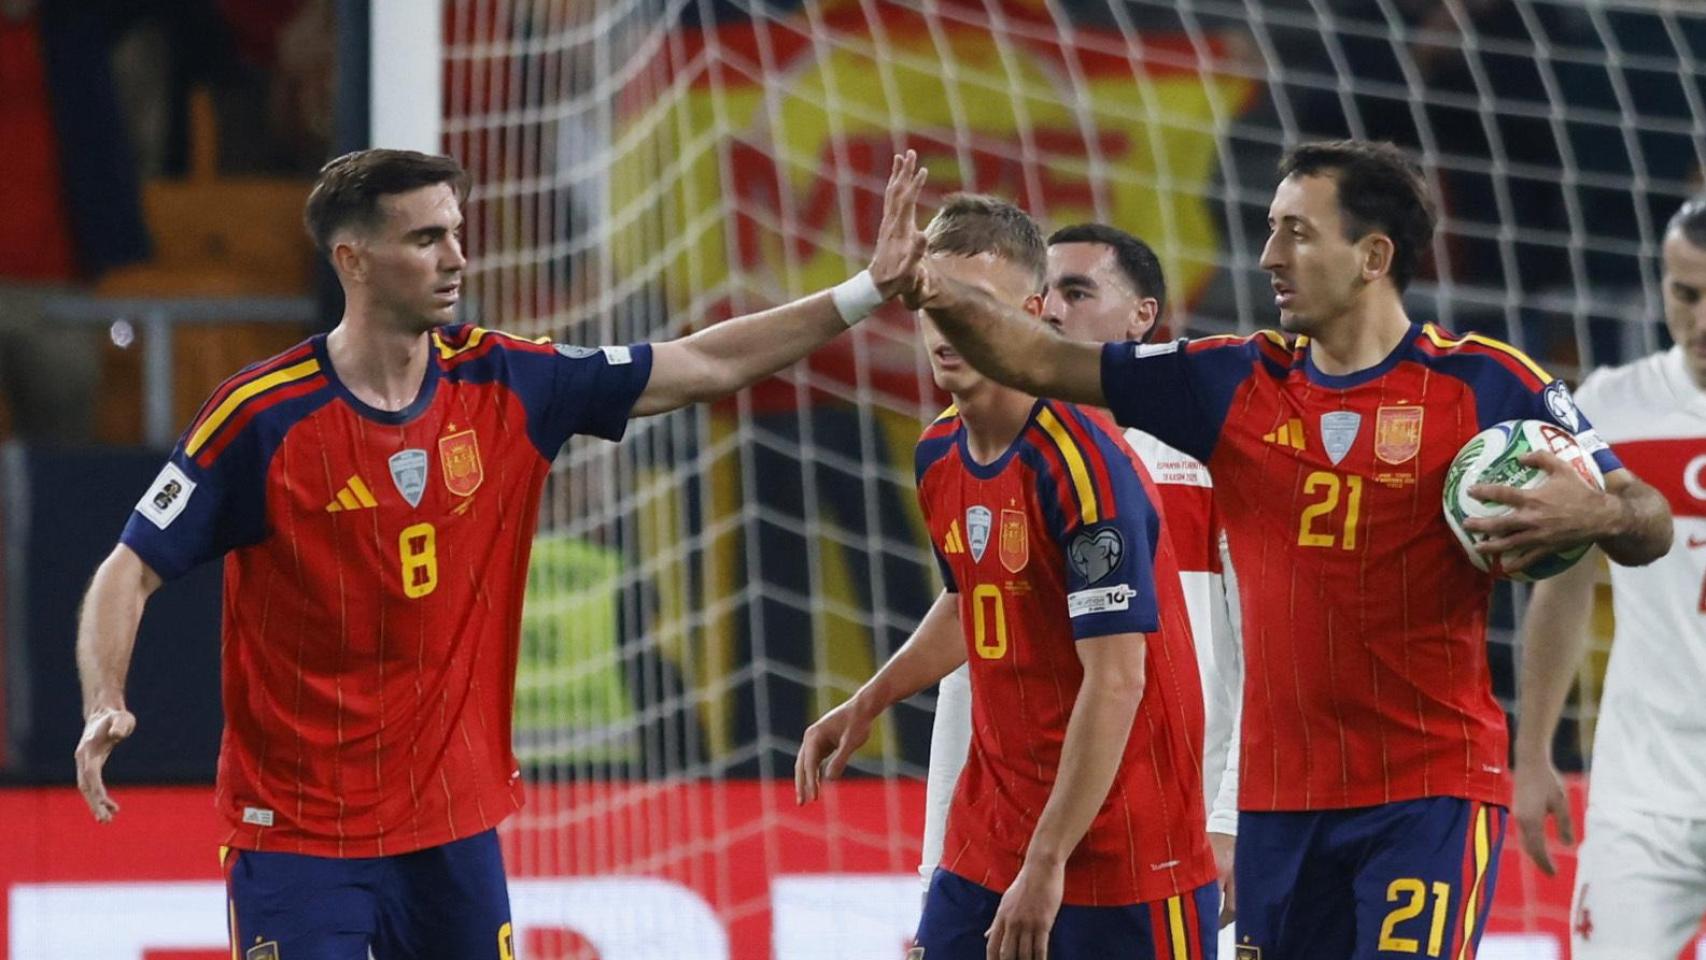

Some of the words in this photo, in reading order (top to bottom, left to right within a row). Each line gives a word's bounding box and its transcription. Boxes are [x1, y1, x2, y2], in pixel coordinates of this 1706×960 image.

[1298, 471, 1362, 550] 21
[399, 522, 437, 599] 8
[1378, 878, 1450, 957] 21
